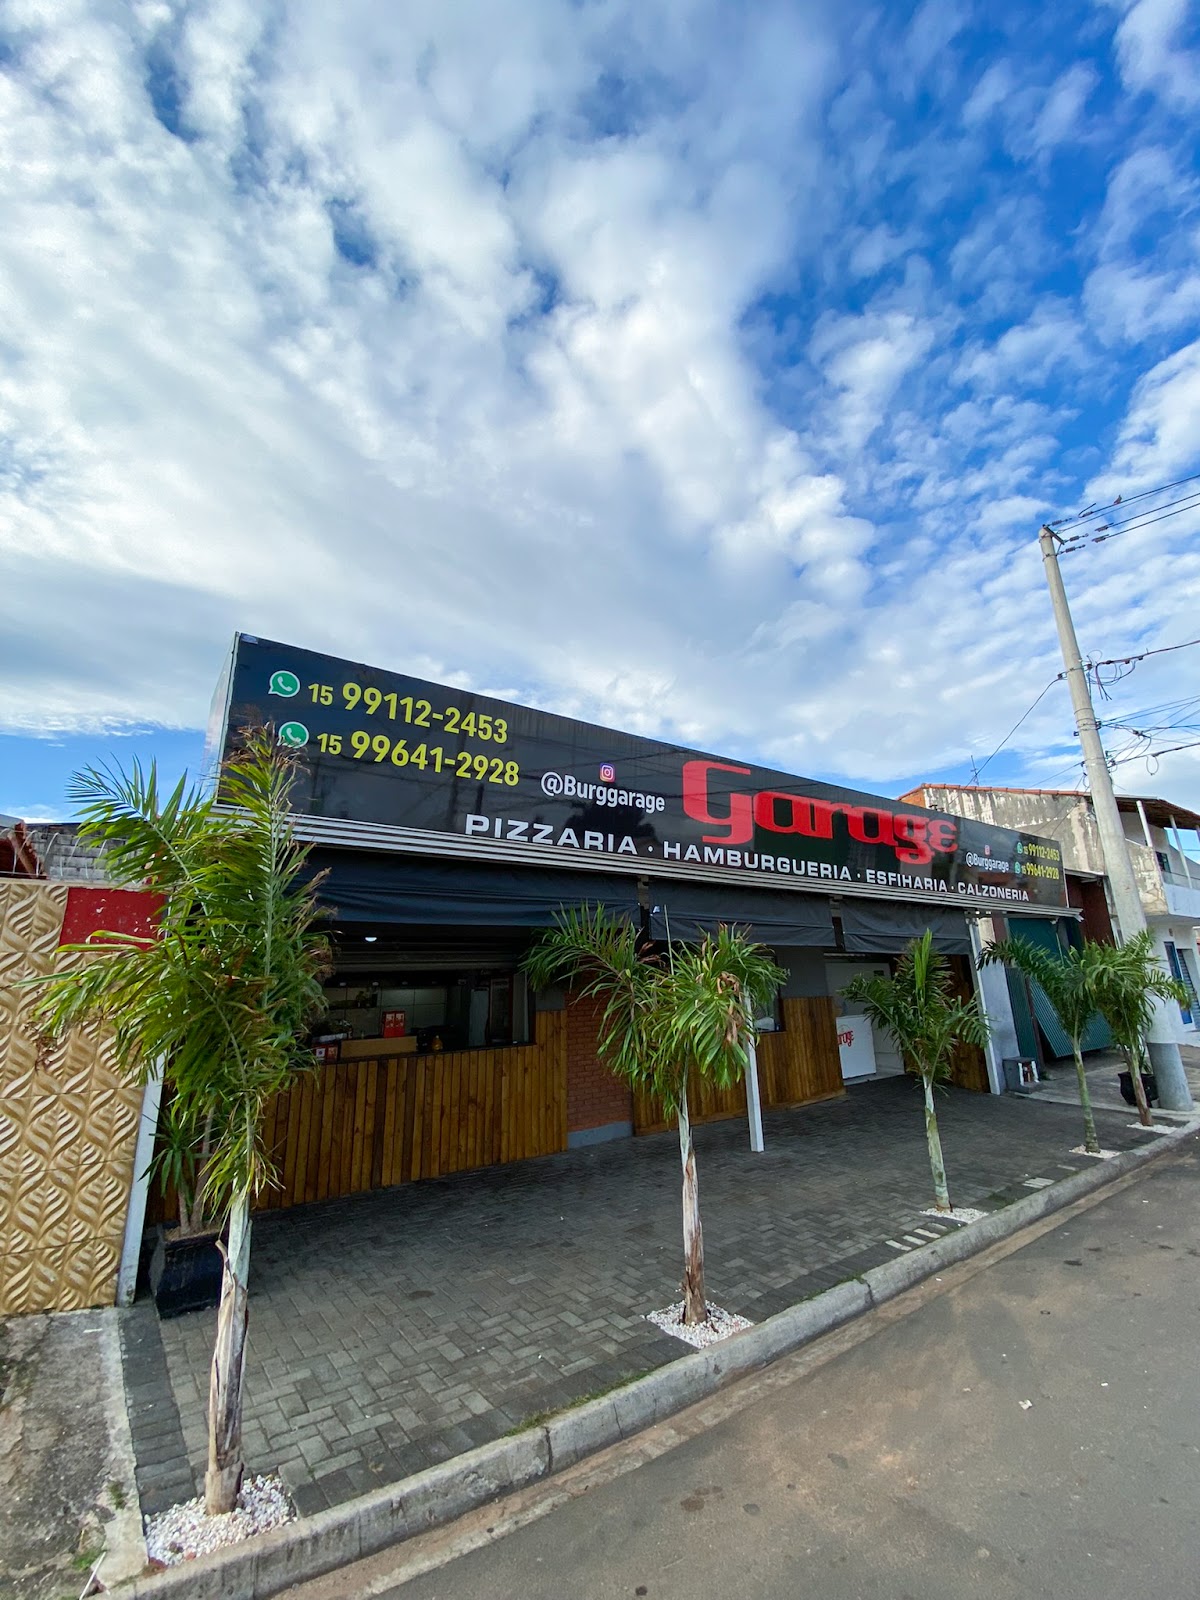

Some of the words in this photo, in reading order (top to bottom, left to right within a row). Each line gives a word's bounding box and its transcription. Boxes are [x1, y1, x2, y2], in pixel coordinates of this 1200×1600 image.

[308, 683, 334, 706] 15
[342, 682, 509, 744] 99112-2453
[317, 733, 342, 755] 15
[350, 731, 520, 786] 99641-2928
[540, 771, 666, 814] @Burggarage
[682, 760, 959, 865] Garage
[465, 814, 637, 855] PIZZARIA
[663, 841, 852, 881] HAMBURGUERIA
[866, 869, 948, 892] ESFIHARIA
[957, 882, 1030, 902] CALZONERIA
[965, 852, 1009, 872] @Burggarage
